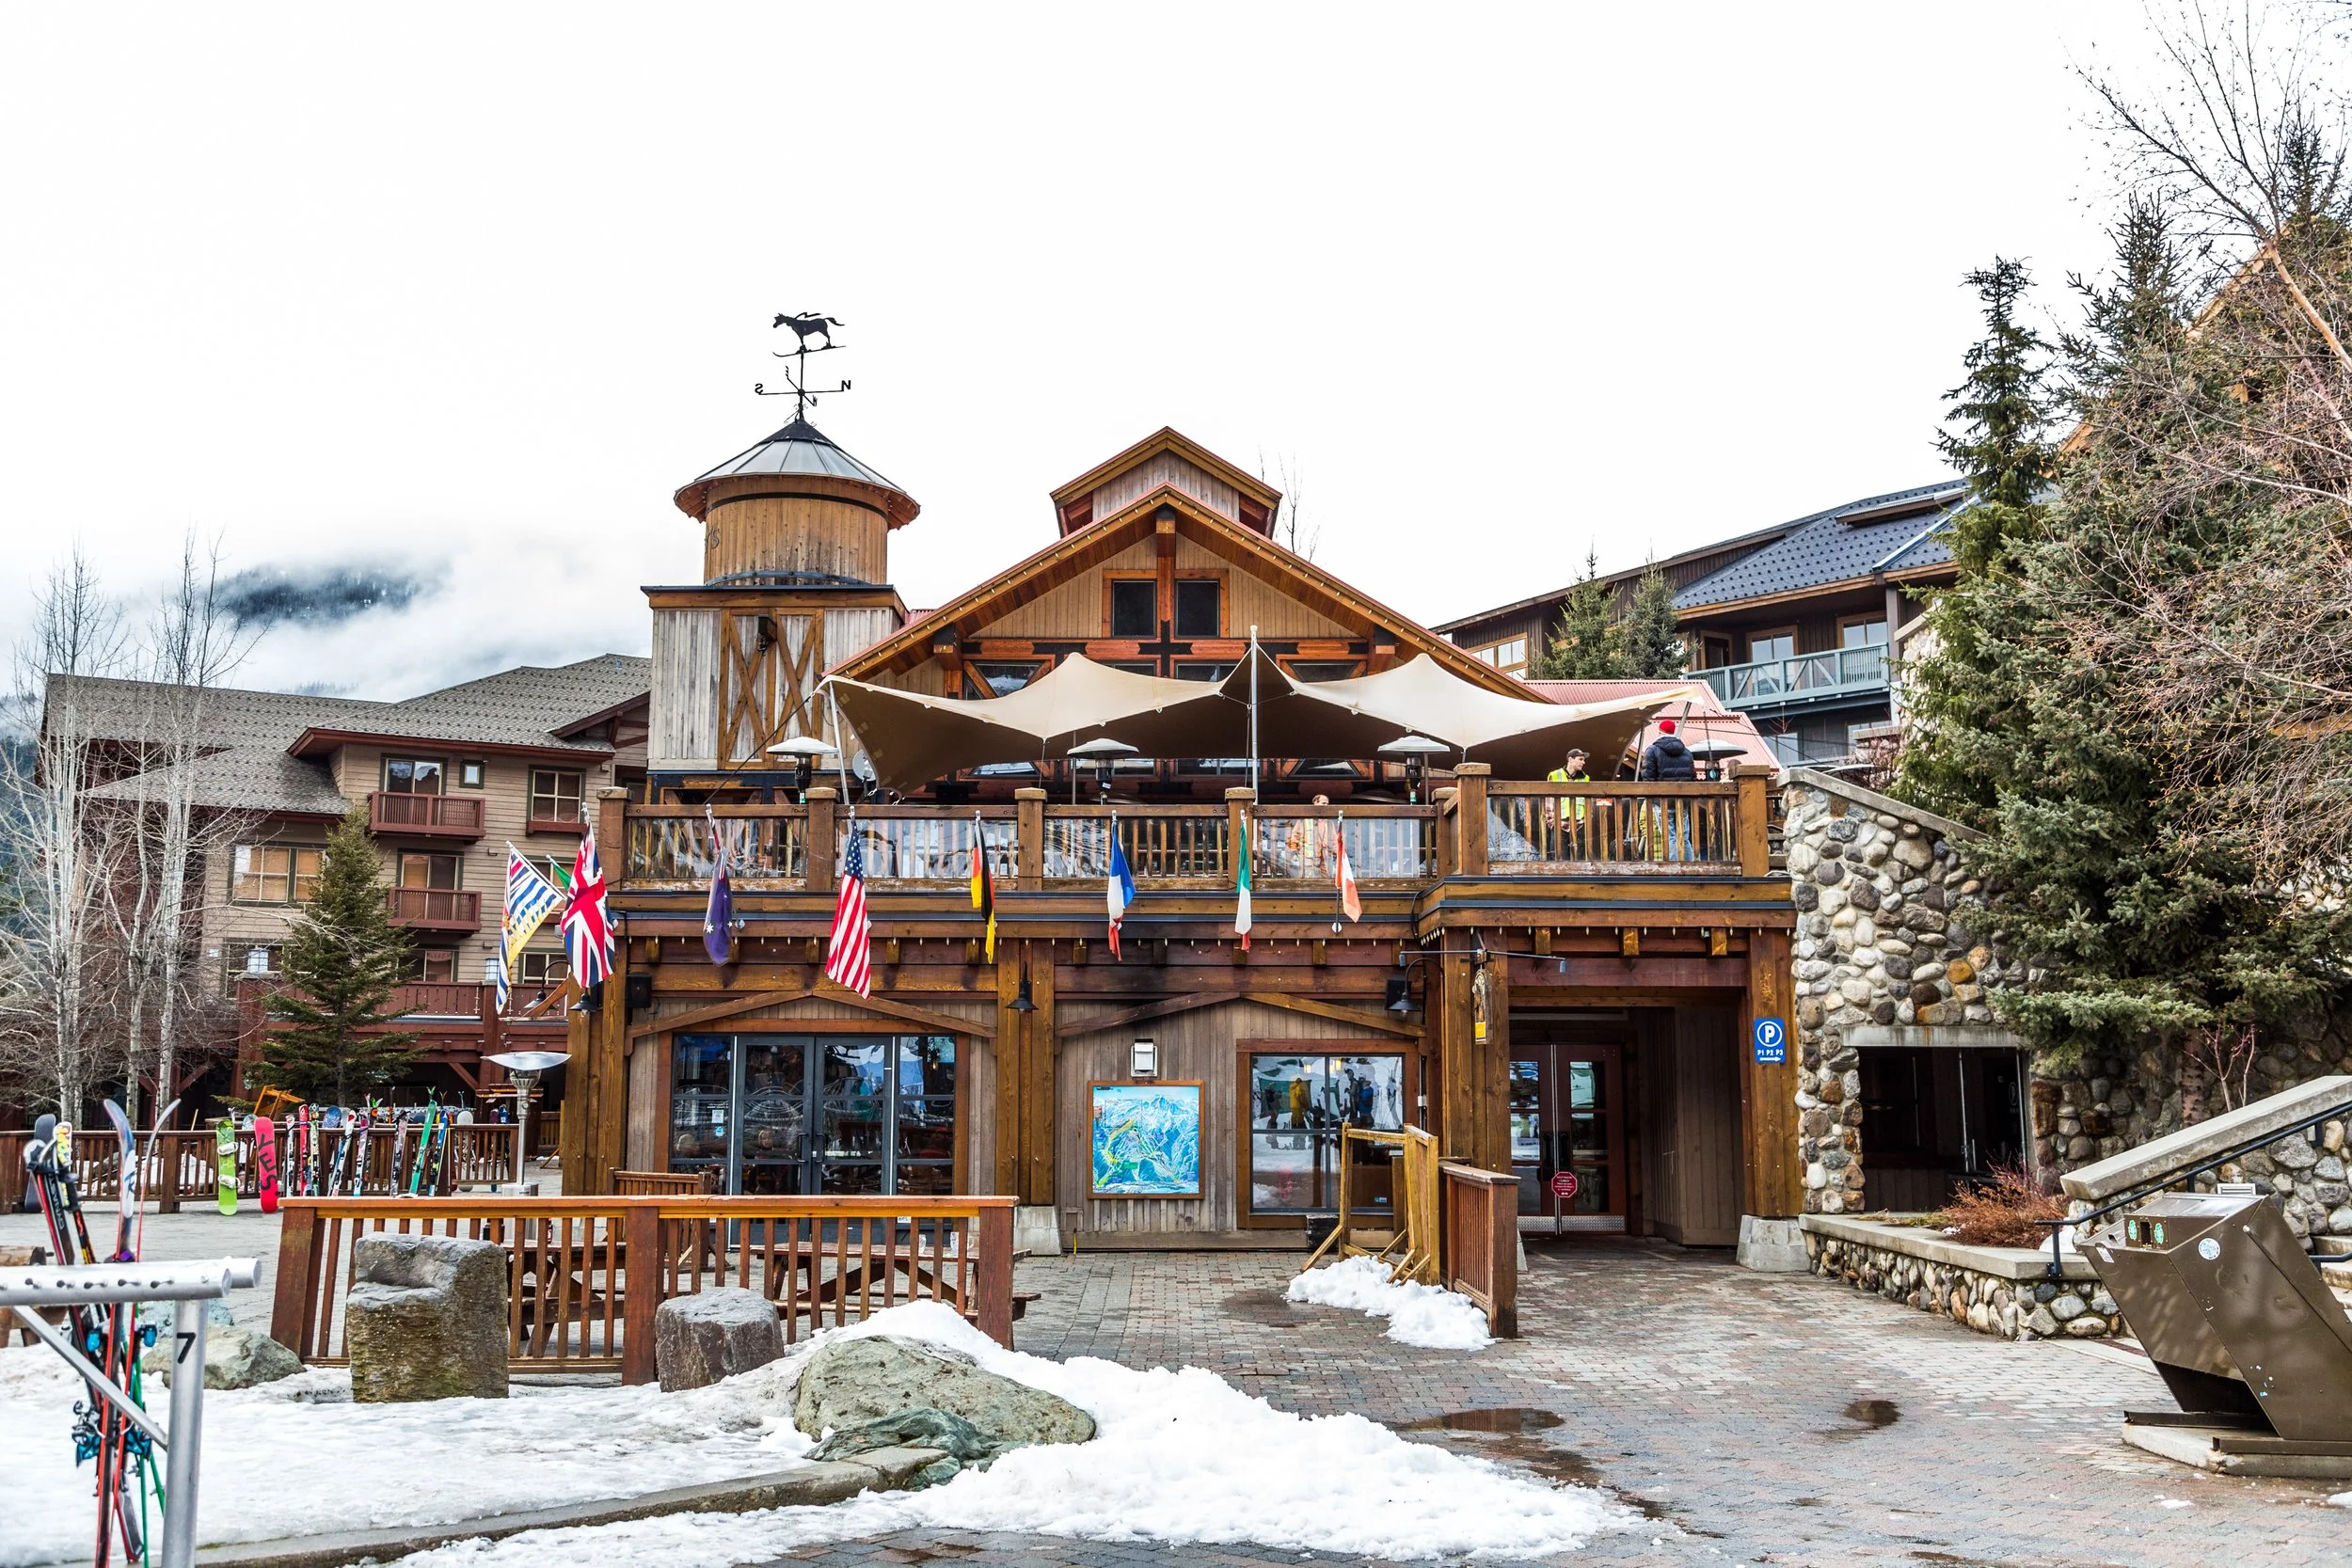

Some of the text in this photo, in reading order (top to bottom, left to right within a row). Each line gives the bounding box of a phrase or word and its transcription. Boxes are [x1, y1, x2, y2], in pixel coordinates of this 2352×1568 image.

[841, 380, 851, 391] N
[1764, 1024, 1775, 1043] P
[48, 1173, 65, 1230] DYNAST
[176, 1332, 196, 1364] 7
